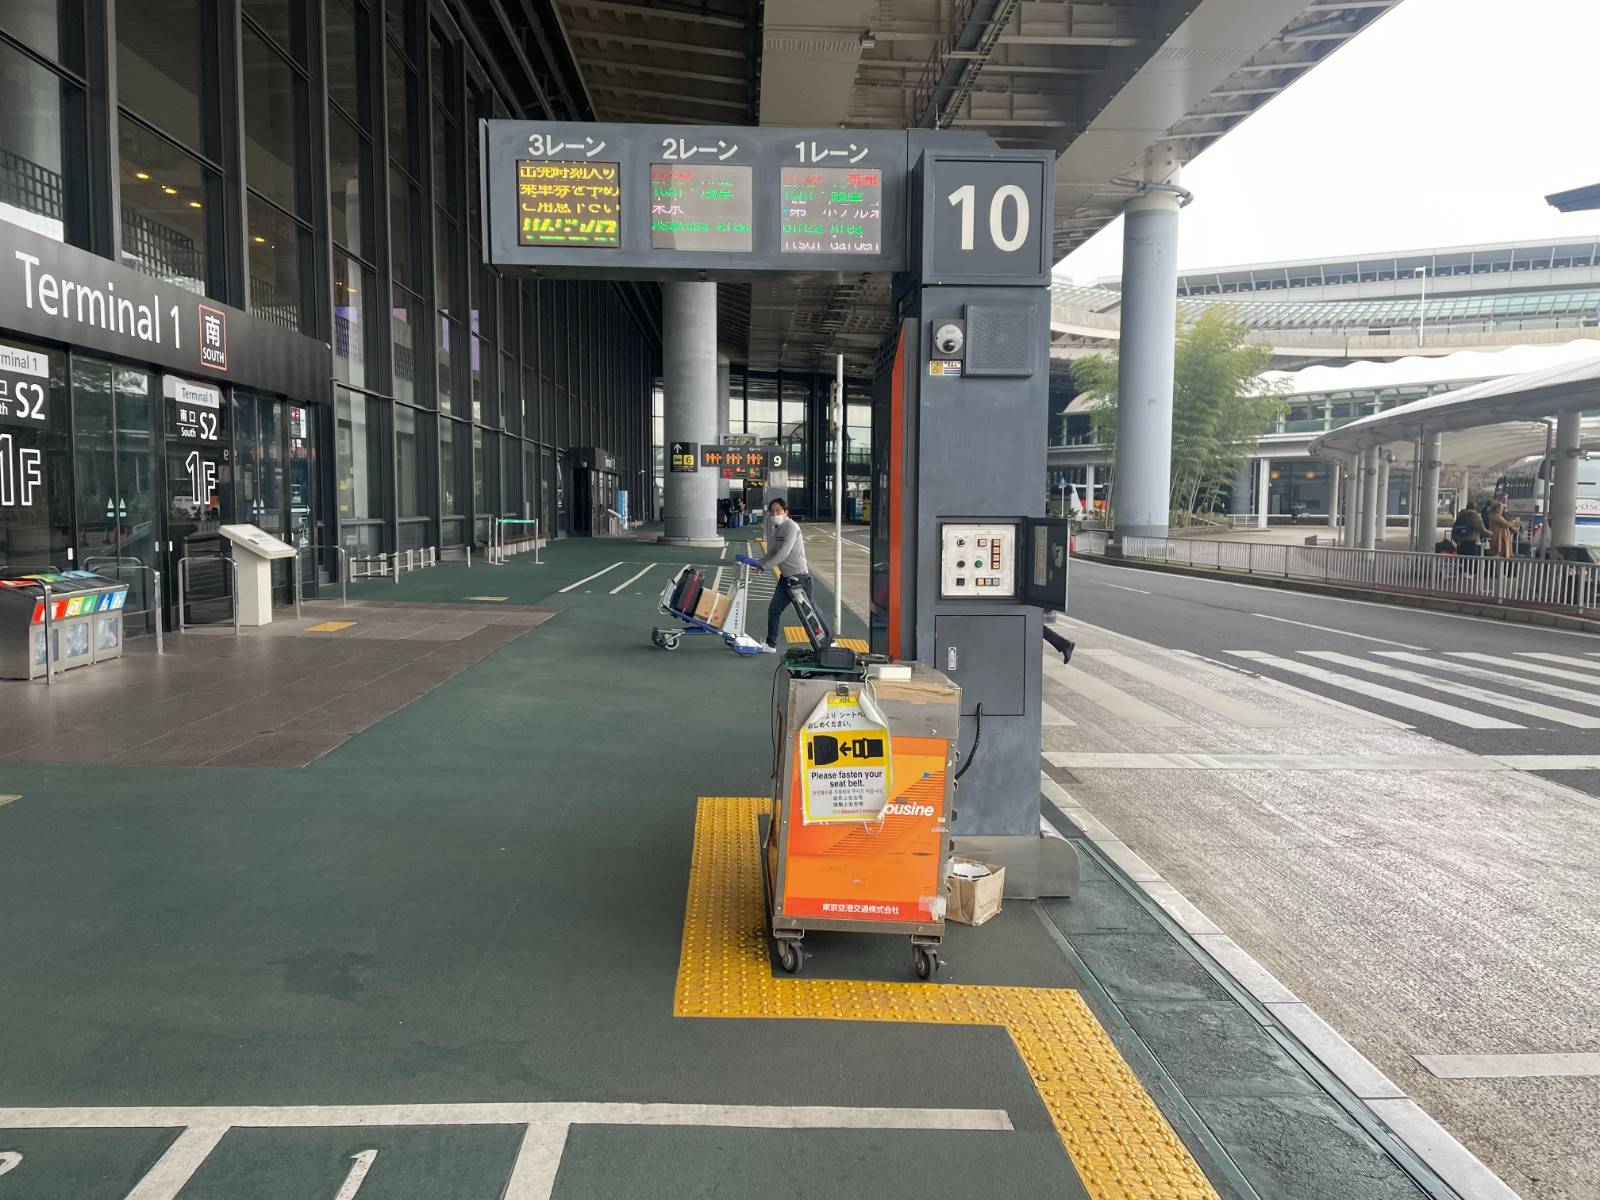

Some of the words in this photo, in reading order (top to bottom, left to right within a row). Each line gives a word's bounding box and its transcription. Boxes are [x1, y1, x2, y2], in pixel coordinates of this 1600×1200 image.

[528, 134, 606, 157] 3レーン
[662, 138, 738, 161] 2レーン
[795, 141, 868, 164] 1レーン
[947, 184, 1030, 252] 10
[15, 250, 161, 344] Terminal
[170, 305, 181, 350] 1
[204, 314, 221, 348] 南
[202, 346, 225, 364] SOUTH
[15, 381, 46, 421] S2
[182, 387, 208, 402] Terminal
[179, 408, 196, 423] 南口
[200, 411, 218, 441] S2
[181, 426, 197, 438] South
[0, 433, 42, 506] 1F
[773, 455, 782, 467] 9
[185, 450, 216, 505] 1F
[839, 711, 867, 719] シートベ
[811, 771, 837, 780] Please
[839, 770, 863, 779] fasten
[864, 771, 883, 779] your
[829, 779, 846, 788] seat
[848, 779, 865, 788] belt.
